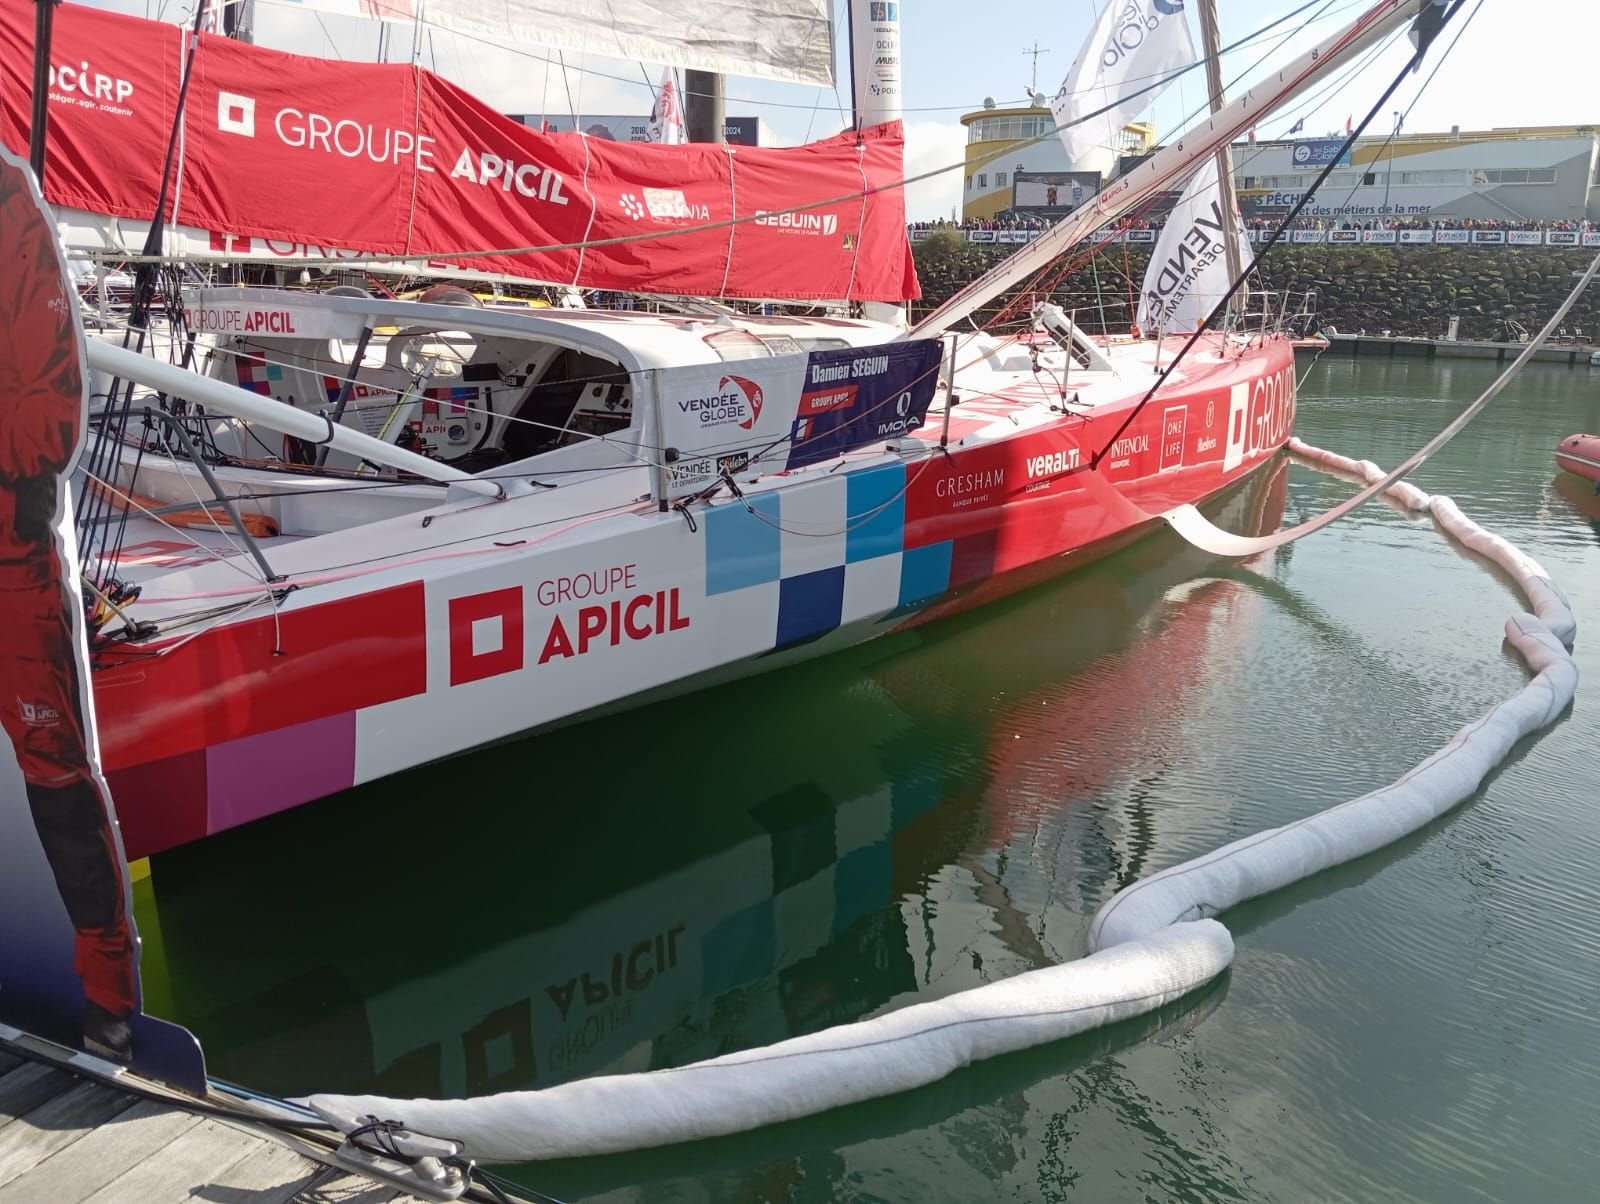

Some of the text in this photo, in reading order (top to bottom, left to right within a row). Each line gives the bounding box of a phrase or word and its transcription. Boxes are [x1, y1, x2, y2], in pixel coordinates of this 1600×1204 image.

[274, 108, 569, 206] GROUPE APICIL
[1266, 192, 1317, 206] PÊCHS
[1300, 203, 1431, 216] et des métiers de la mer
[755, 210, 820, 229] SEGUIN
[193, 310, 295, 333] GROUPE APICIL
[812, 356, 889, 384] Damien SEGUIN
[678, 393, 739, 412] VENDÉE
[811, 395, 833, 409] GROUPE
[700, 405, 746, 422] GLOBE
[1168, 420, 1182, 436] ONE
[1165, 443, 1181, 458] LIFE
[671, 460, 711, 480] VENDÉE
[537, 564, 636, 606] GROUPE
[537, 587, 690, 665] APICIL
